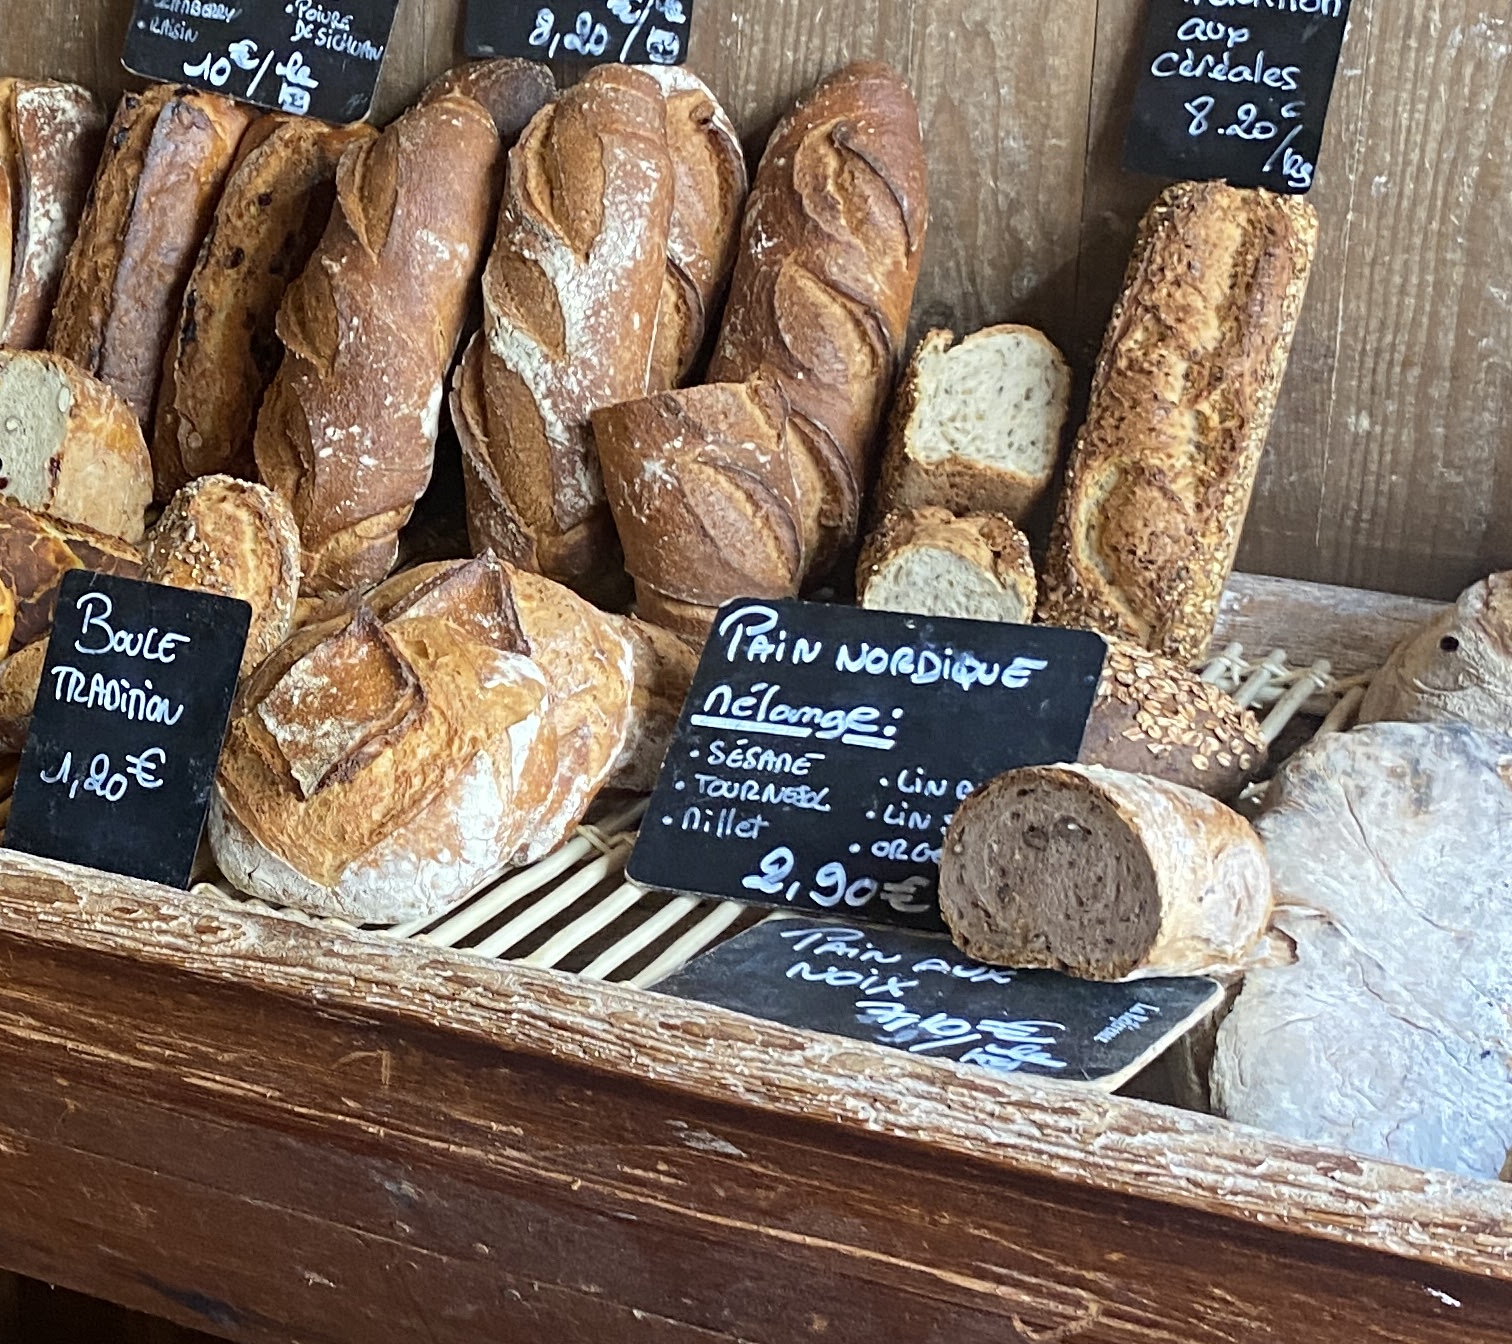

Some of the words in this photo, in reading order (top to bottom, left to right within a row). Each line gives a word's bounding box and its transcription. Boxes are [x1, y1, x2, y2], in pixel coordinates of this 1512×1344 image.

[290, 19, 315, 42] DE
[1177, 16, 1251, 48] aux
[1150, 47, 1302, 91] Céréales
[40, 746, 166, 802] 1,20€
[742, 846, 932, 914] 2,90€
[911, 958, 1017, 985] AUX
